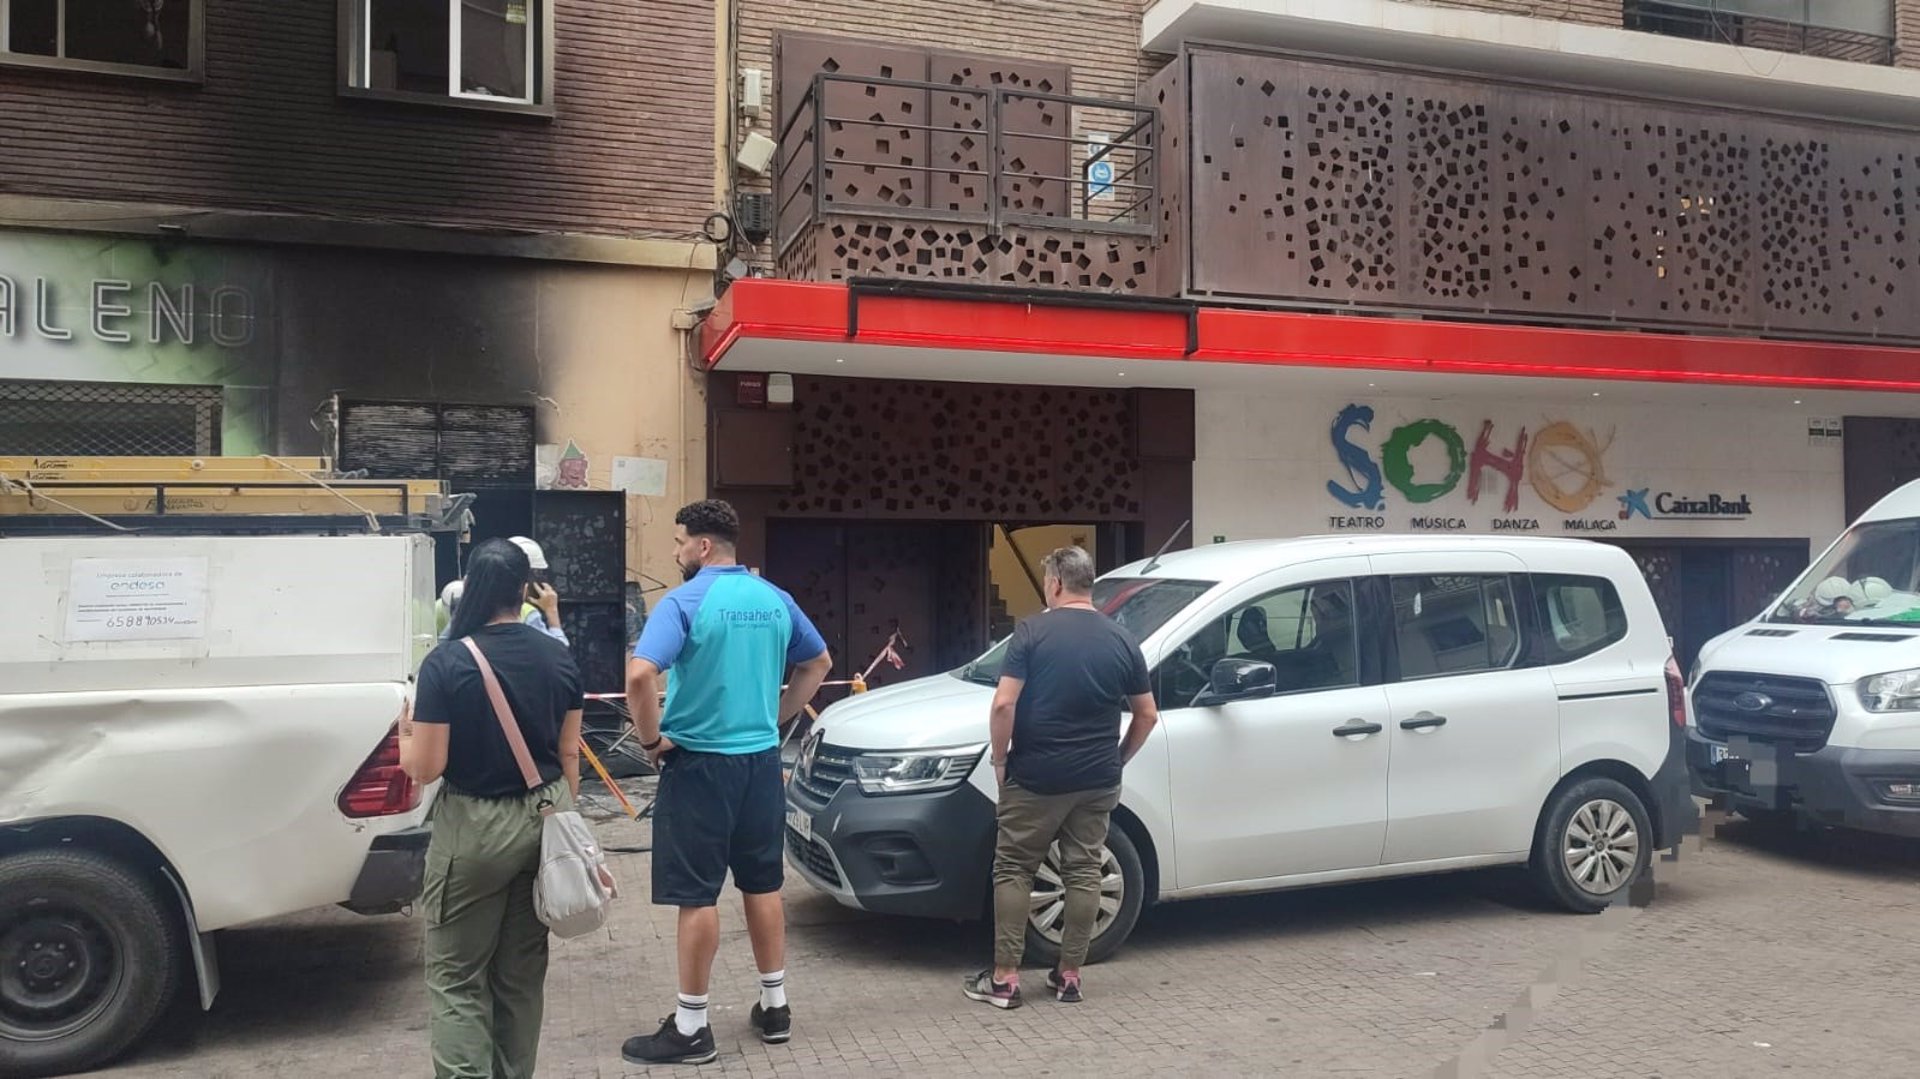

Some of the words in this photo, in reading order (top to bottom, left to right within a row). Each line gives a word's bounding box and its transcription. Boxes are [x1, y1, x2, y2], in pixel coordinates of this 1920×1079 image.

[1327, 403, 1616, 514] SOHO
[1655, 492, 1752, 514] CaixaBank
[1329, 516, 1385, 529] TEATRO
[1492, 518, 1540, 531] DANZA
[110, 580, 165, 590] endesa
[719, 608, 773, 621] Transaher
